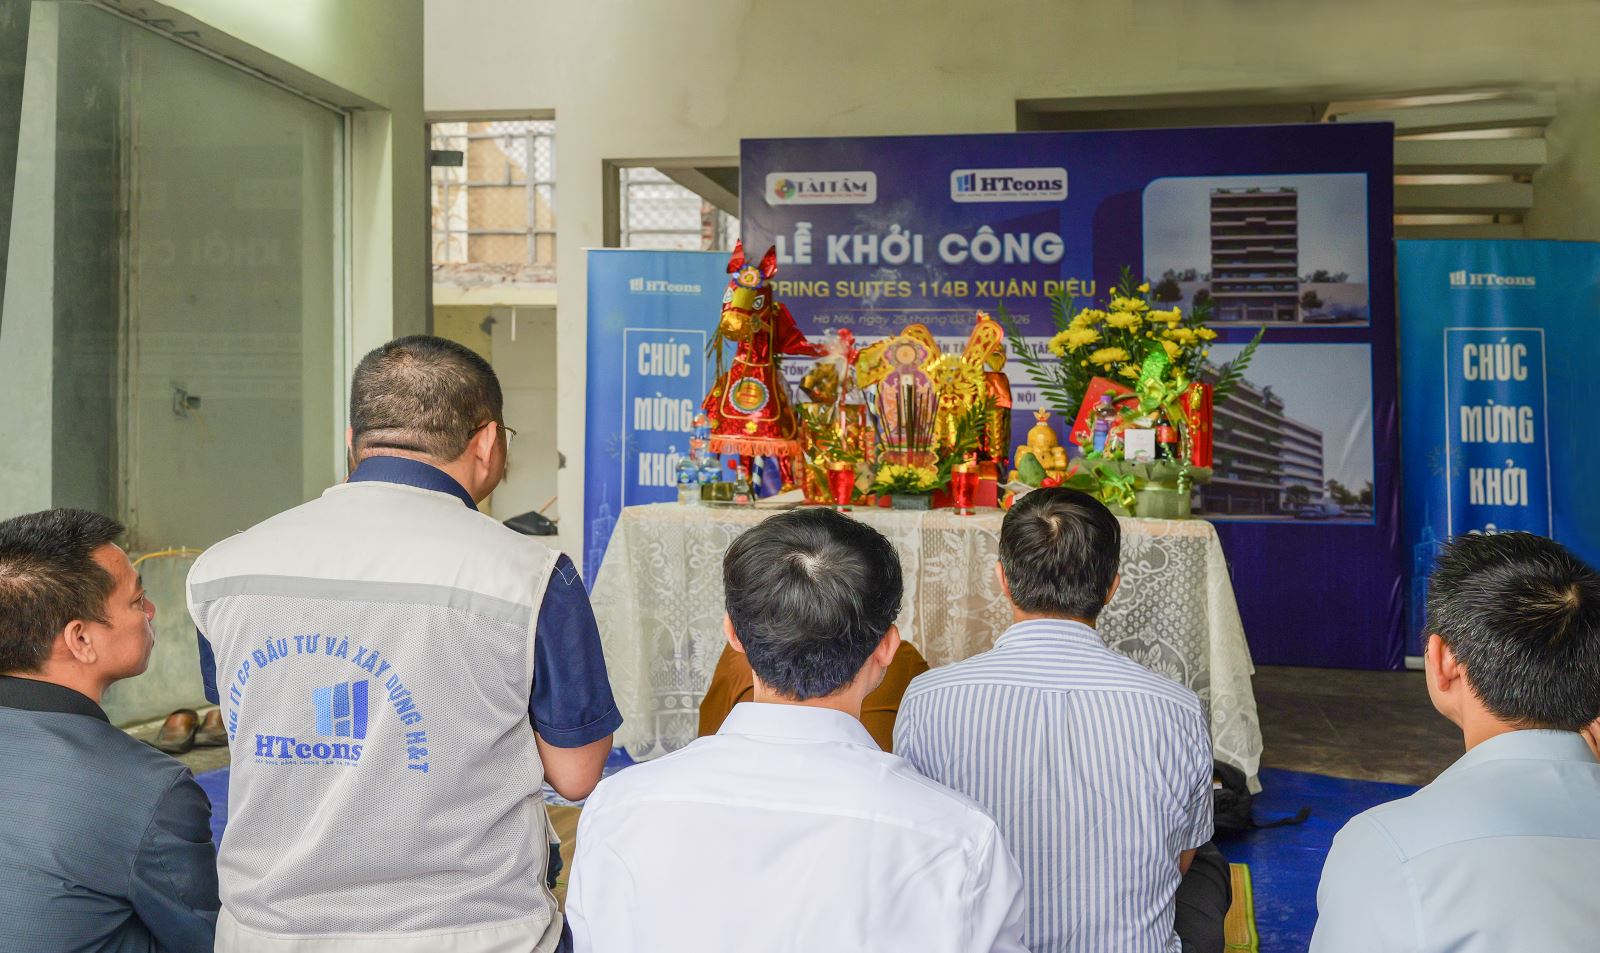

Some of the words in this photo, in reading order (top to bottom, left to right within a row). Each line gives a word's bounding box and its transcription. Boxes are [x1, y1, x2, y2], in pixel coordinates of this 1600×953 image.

[980, 176, 1063, 192] HTcons
[775, 221, 812, 264] LỄ
[827, 223, 923, 264] KHỞI
[938, 225, 1065, 264] CÔNG
[646, 280, 702, 293] HTcons
[769, 280, 830, 297] PRING
[836, 280, 912, 298] SUITES
[919, 280, 969, 297] 114B
[975, 278, 1037, 297] XUÂN
[1470, 273, 1537, 286] HTcons
[858, 314, 888, 328] ngày
[909, 313, 947, 327] tháng
[638, 338, 692, 378] CHÚC
[1462, 337, 1529, 381] CHÚC
[634, 392, 694, 433] MỪNG
[1017, 391, 1036, 405] NỘI
[1460, 399, 1535, 444] MỪNG
[638, 445, 680, 488] KHỞ
[1469, 458, 1529, 506] KHỞI
[237, 660, 251, 686] CP
[293, 633, 321, 655] TƯ
[325, 635, 349, 660] VÀ
[352, 646, 392, 678] XÂY
[385, 673, 423, 726] DỰNG
[405, 730, 430, 774] H&T
[254, 733, 363, 762] HTcons
